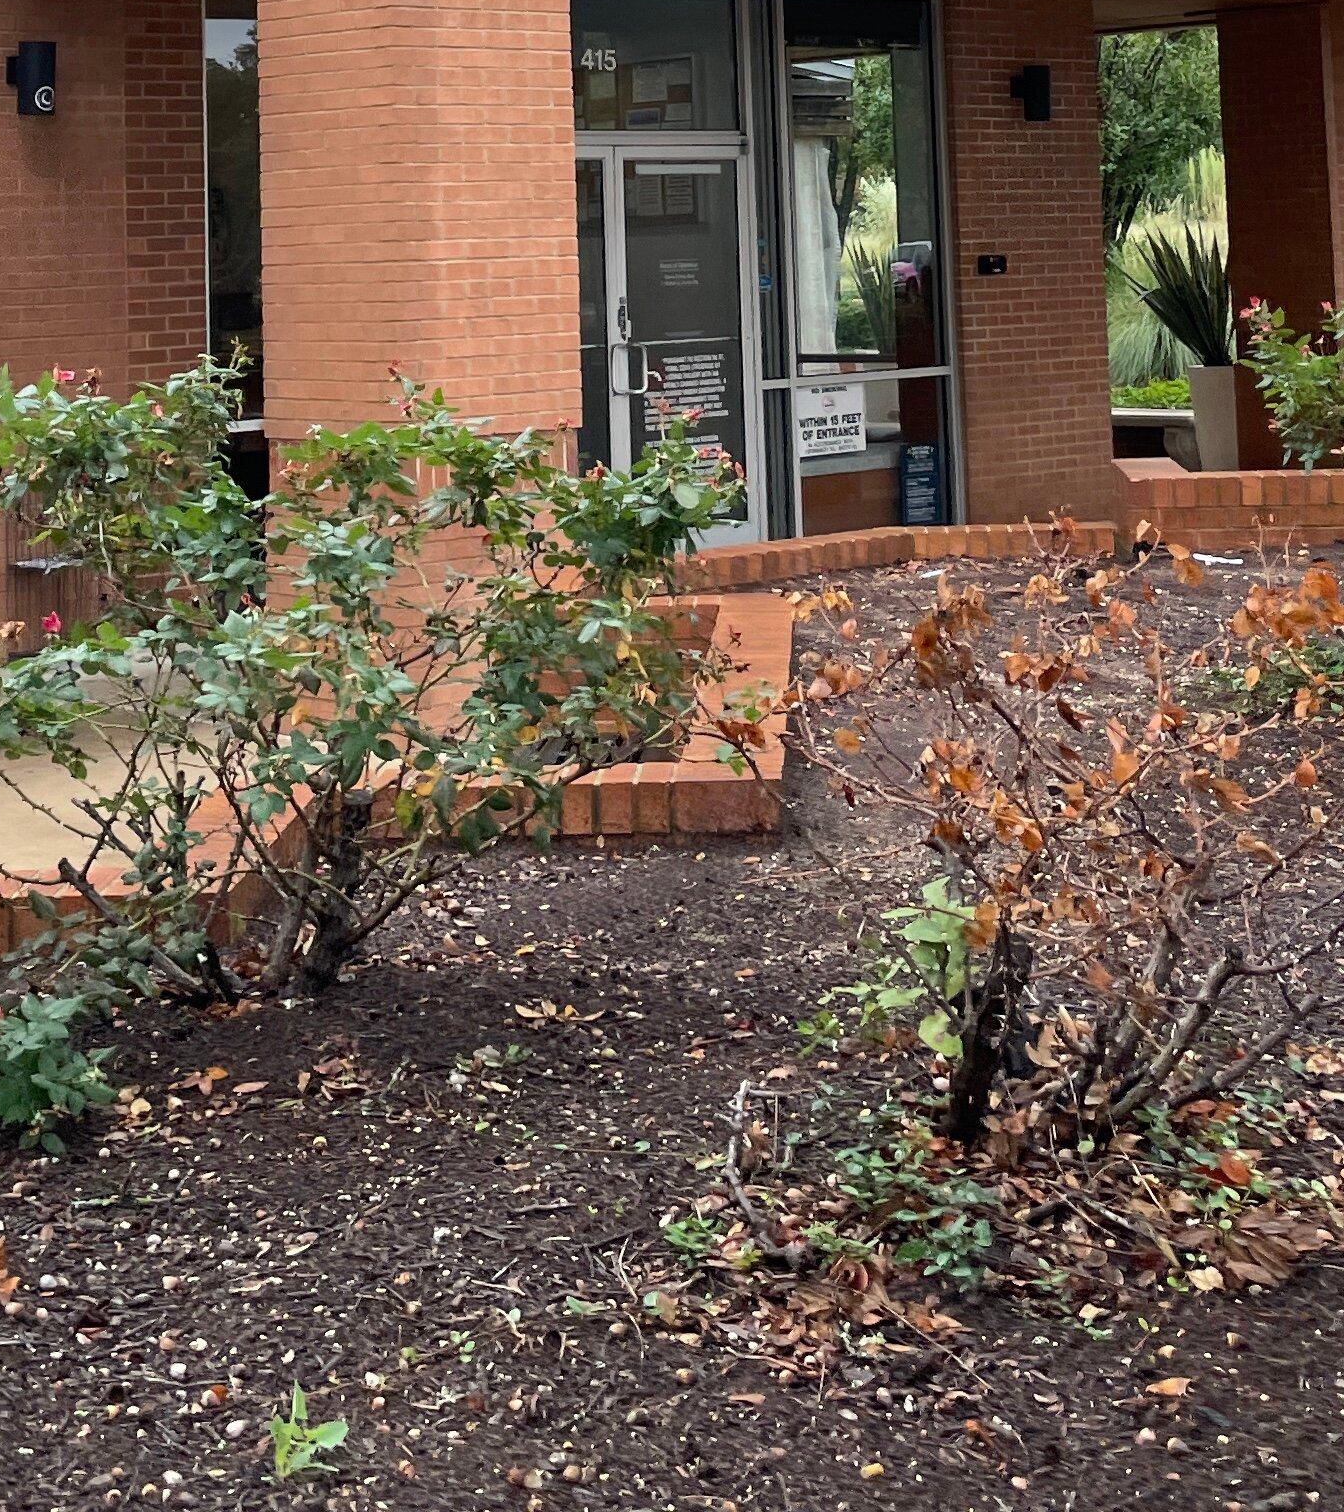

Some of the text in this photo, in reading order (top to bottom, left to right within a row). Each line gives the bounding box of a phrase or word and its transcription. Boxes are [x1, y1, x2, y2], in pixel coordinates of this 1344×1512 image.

[580, 48, 617, 71] 415
[798, 416, 828, 429] WITHIN
[841, 412, 862, 424] FEET
[802, 424, 860, 441] OF ENTRANCE
